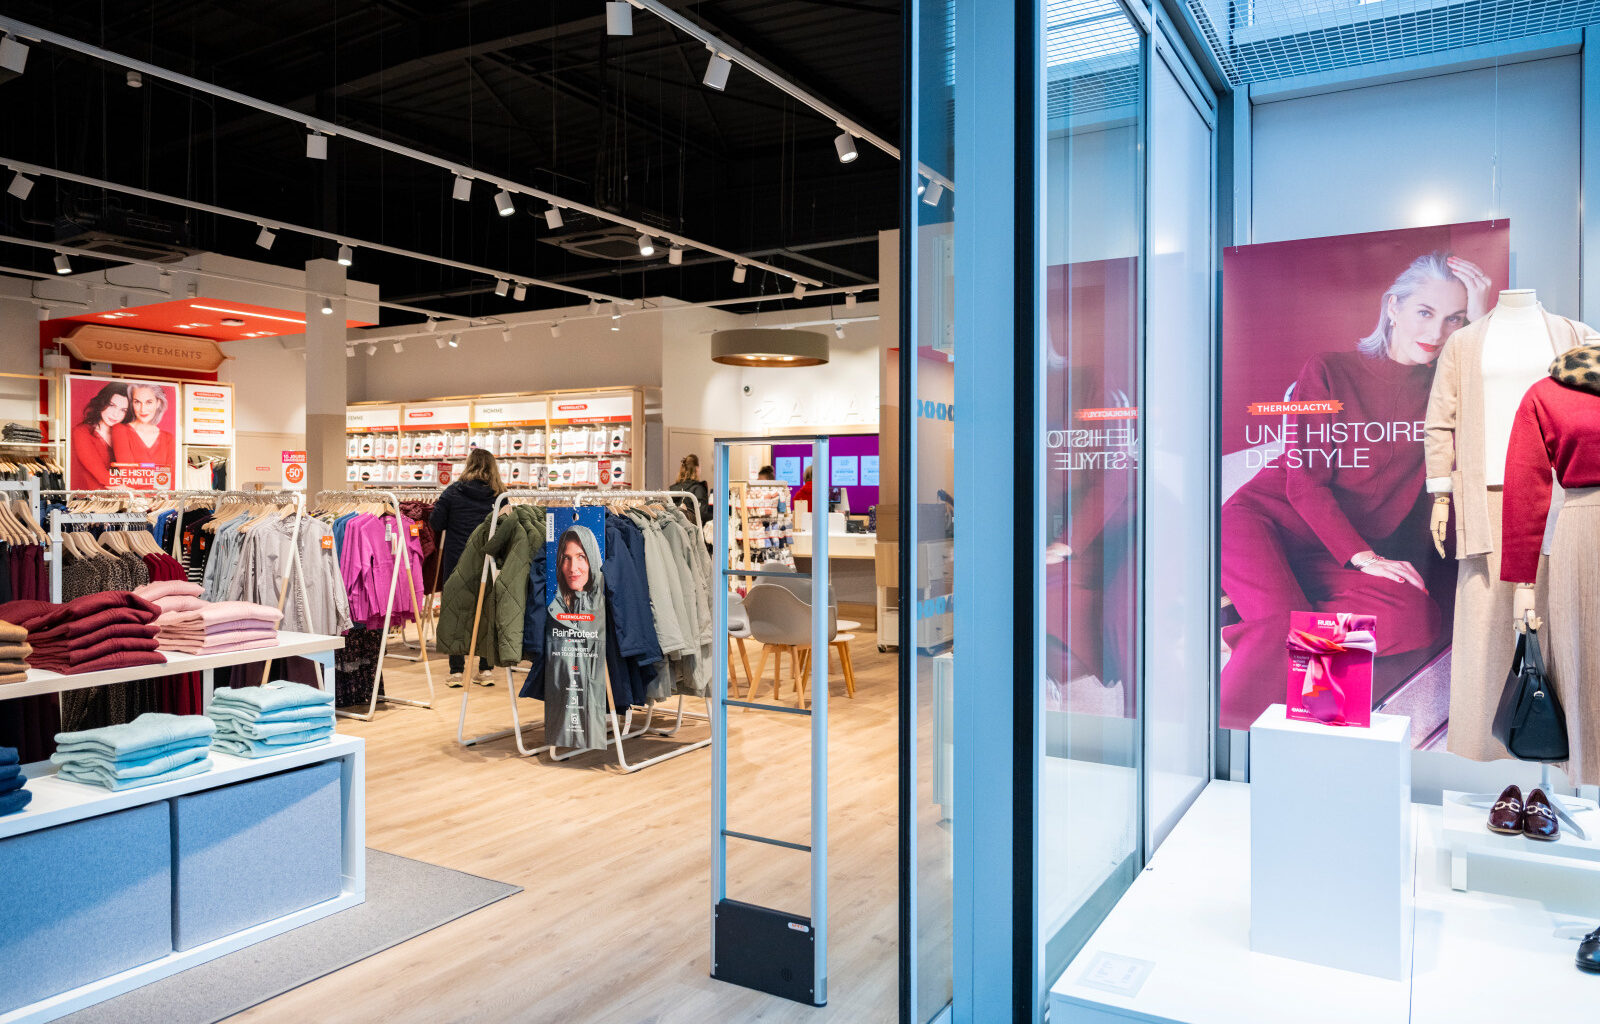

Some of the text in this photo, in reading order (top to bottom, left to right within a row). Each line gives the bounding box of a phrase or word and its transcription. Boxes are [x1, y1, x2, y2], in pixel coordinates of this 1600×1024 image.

[96, 340, 203, 360] SOUS-VÊTEMENTS
[1257, 402, 1334, 413] THERMOLACTYL
[1245, 421, 1427, 445] UNE HISTOIRE
[1245, 447, 1370, 469] DE STYLE
[109, 468, 127, 477] UNE
[128, 468, 154, 477] HISTOI
[109, 477, 154, 486] DE FAMILLE
[1317, 619, 1336, 627] RUBA
[552, 628, 599, 639] RainProtect
